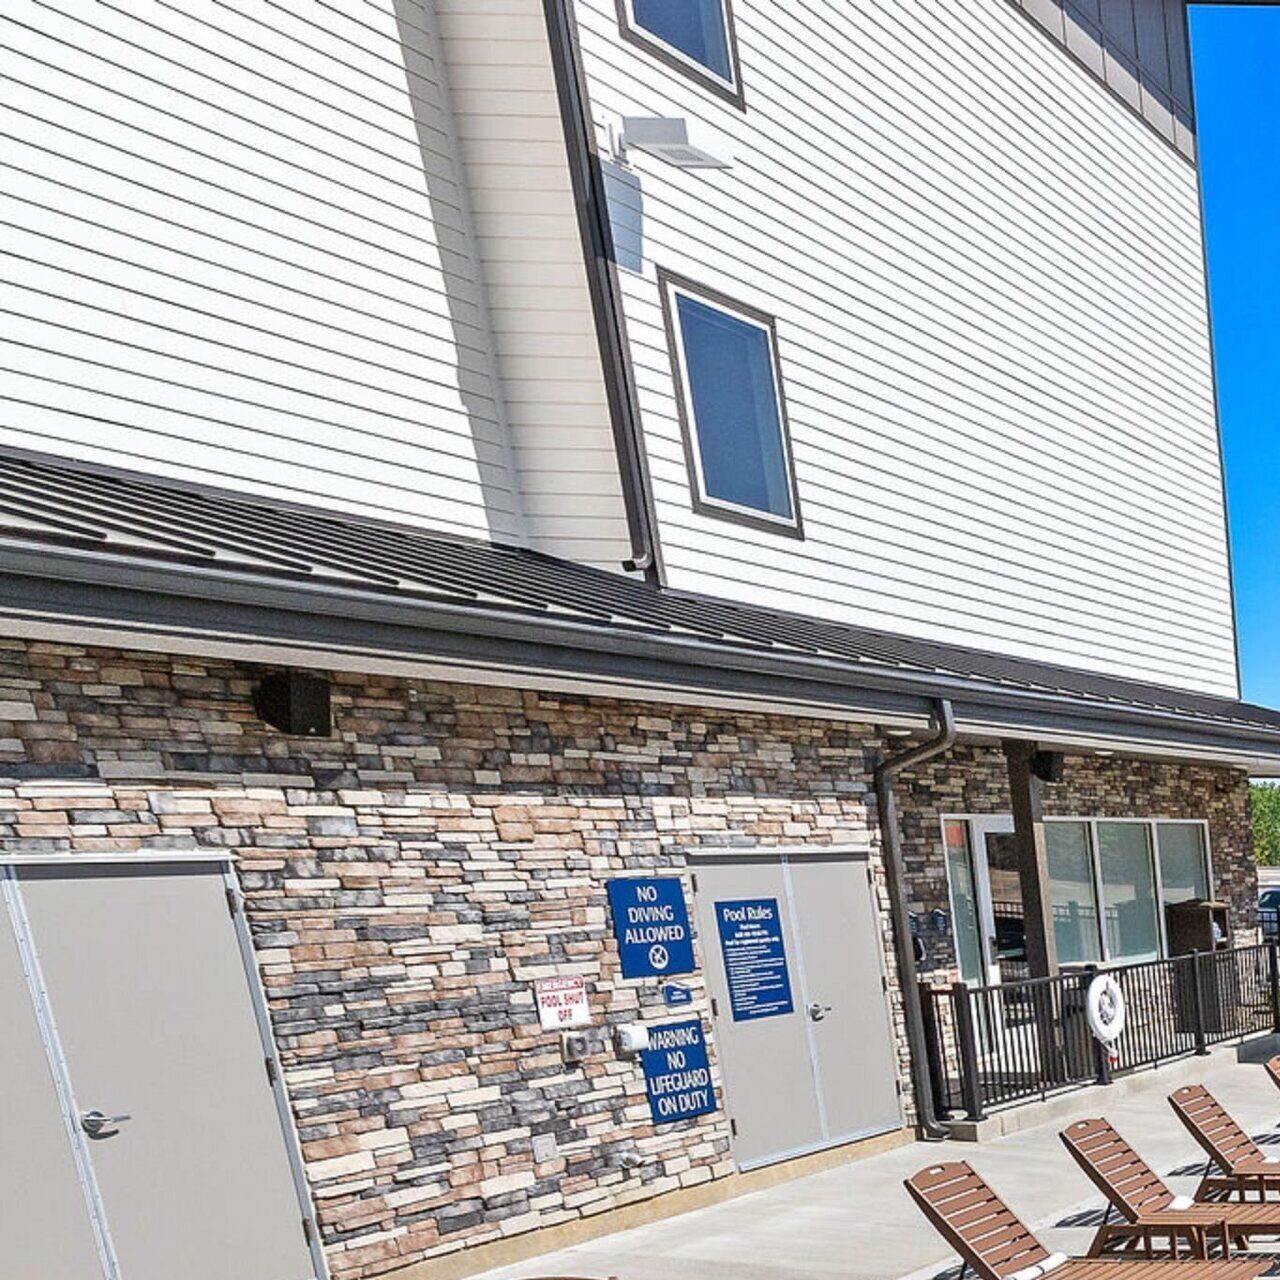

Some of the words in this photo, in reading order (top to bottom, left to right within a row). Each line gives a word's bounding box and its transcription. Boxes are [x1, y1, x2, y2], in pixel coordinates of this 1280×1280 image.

[636, 886, 657, 902] NO
[627, 905, 674, 923] DIVING
[723, 907, 746, 922] Pool
[747, 905, 773, 920] Rules
[625, 924, 685, 944] ALLOWED
[541, 994, 562, 1008] POOL
[563, 991, 584, 1006] SHUT
[558, 1008, 572, 1022] OFF
[648, 1026, 700, 1051] WARNING
[667, 1050, 686, 1070] NO
[650, 1068, 708, 1095] LIFEGUARD
[658, 1096, 678, 1116] ON
[678, 1089, 708, 1112] DUTY
